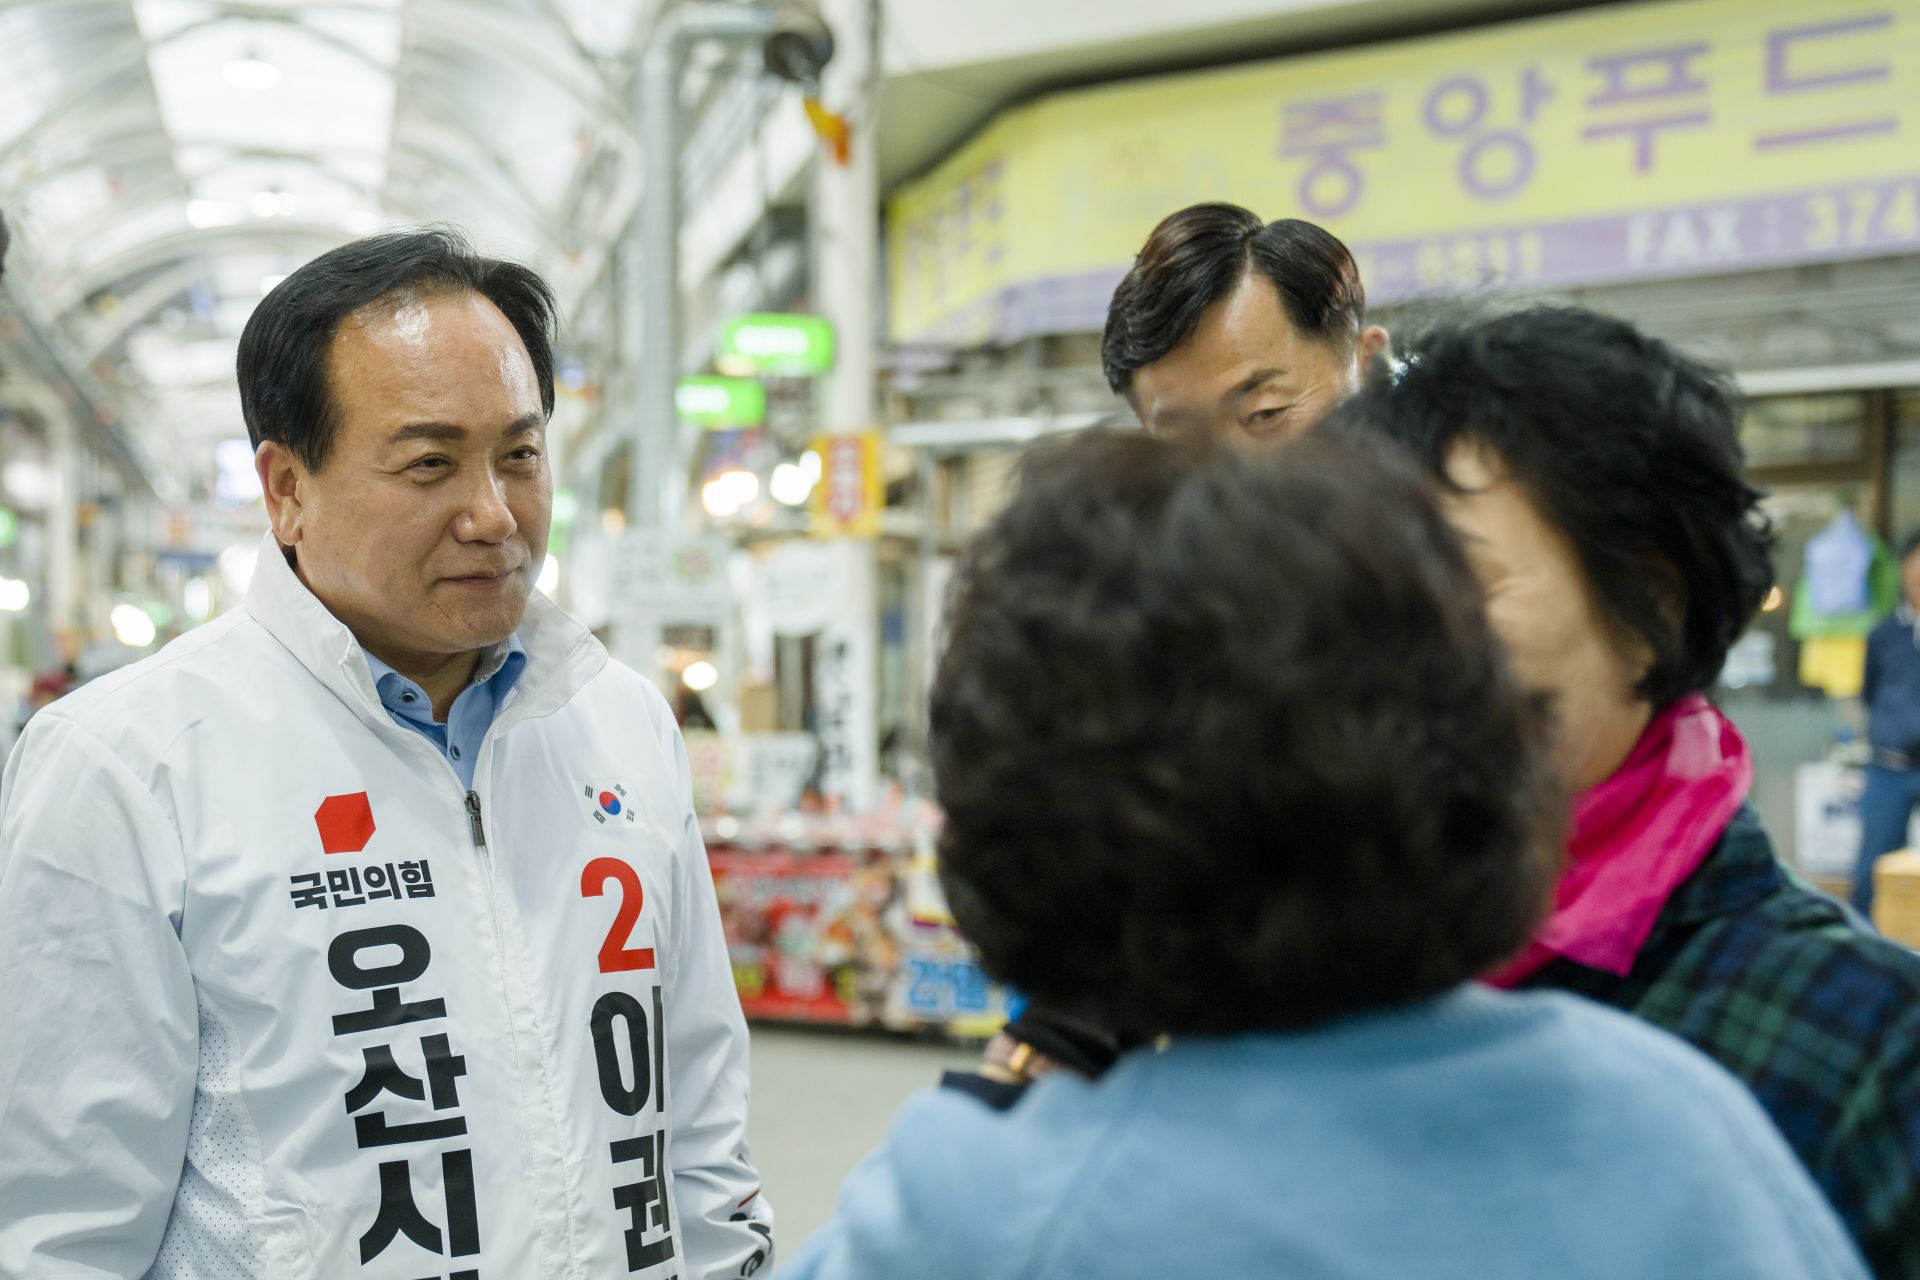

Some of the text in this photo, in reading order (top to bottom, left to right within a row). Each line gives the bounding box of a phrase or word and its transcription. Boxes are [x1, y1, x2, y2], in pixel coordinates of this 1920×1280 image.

[1278, 14, 1900, 218] 중앙푸드
[1627, 207, 1743, 268] FAX
[290, 859, 436, 910] 국민의힘
[580, 857, 655, 974] 2
[327, 924, 481, 1280] 오산시
[590, 985, 679, 1280] 이권
